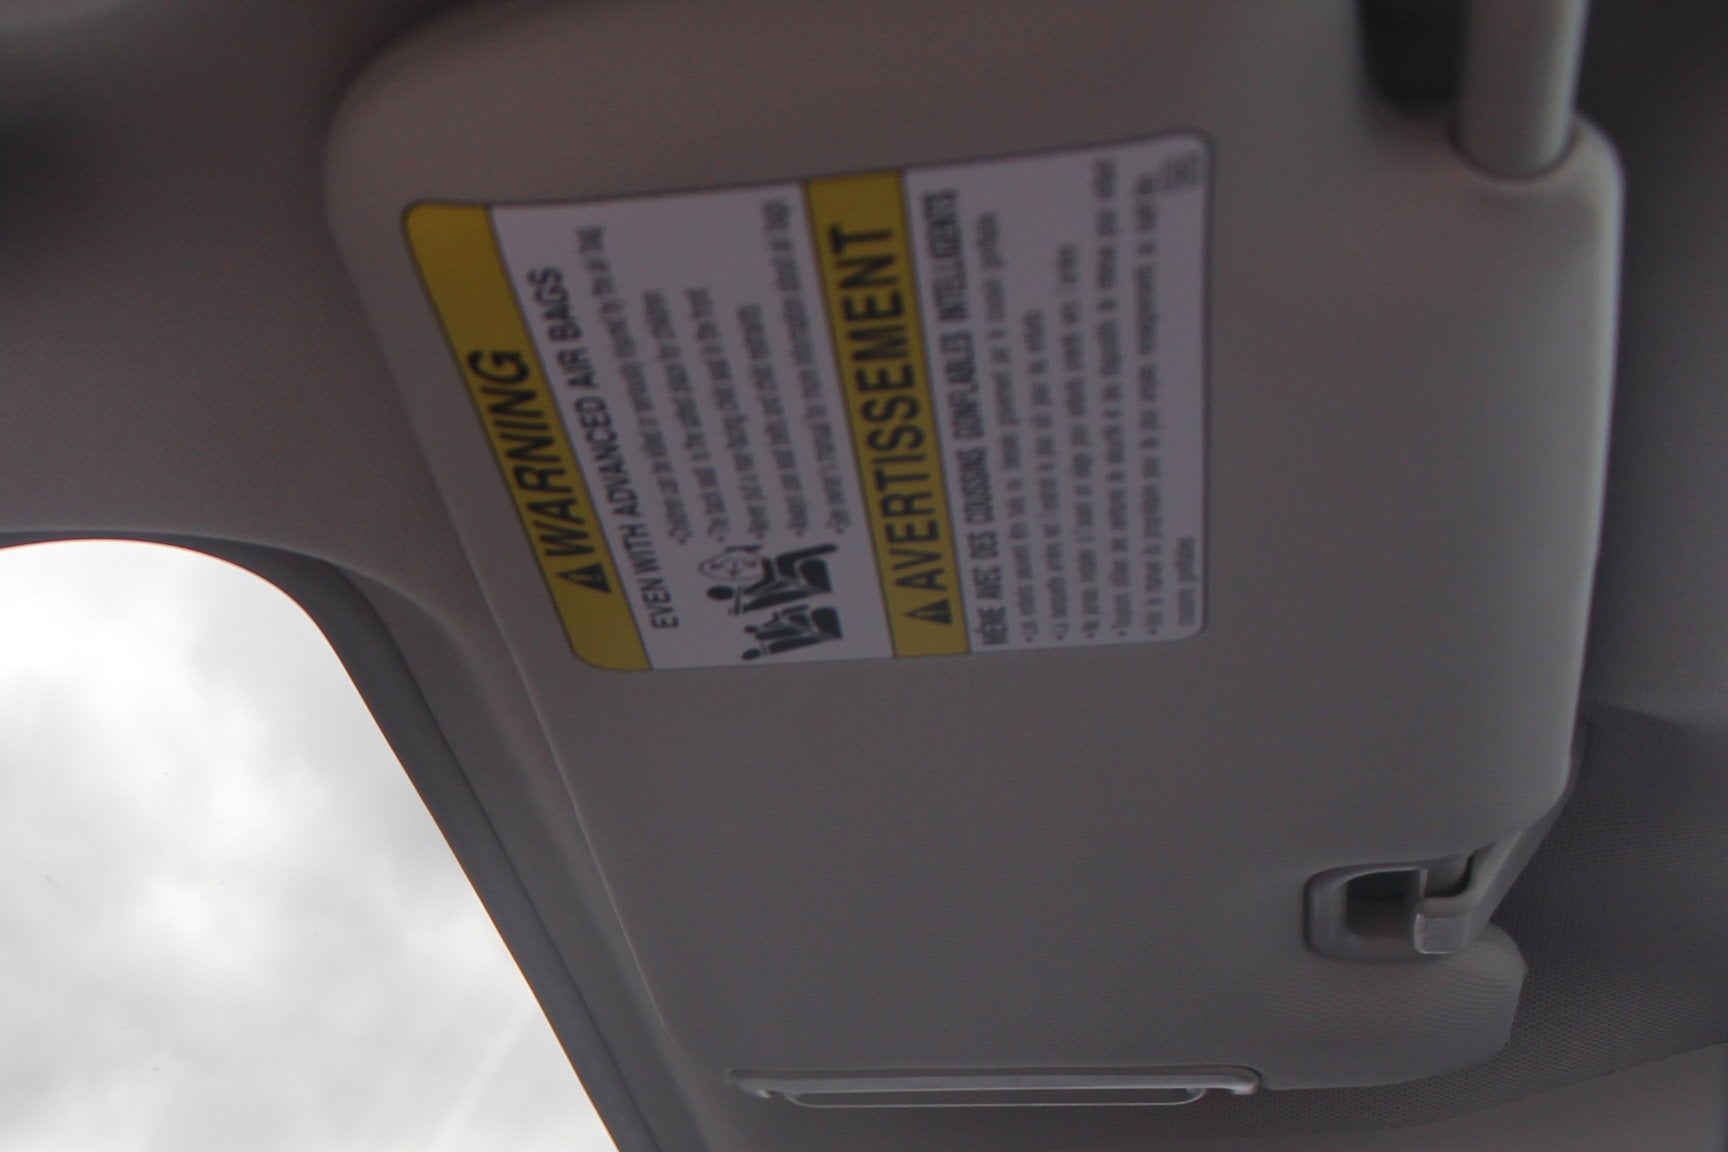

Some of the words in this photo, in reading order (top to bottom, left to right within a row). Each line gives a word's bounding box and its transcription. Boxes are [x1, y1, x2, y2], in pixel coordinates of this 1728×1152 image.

[527, 268, 581, 340] BAGS
[557, 348, 595, 387] AIR
[827, 224, 945, 590] AVERTISSEMENT
[466, 350, 594, 556] WARNING
[574, 396, 640, 516] ADVANCED
[620, 523, 658, 573] WITH
[967, 531, 998, 559] DES
[640, 577, 679, 628] EVEN
